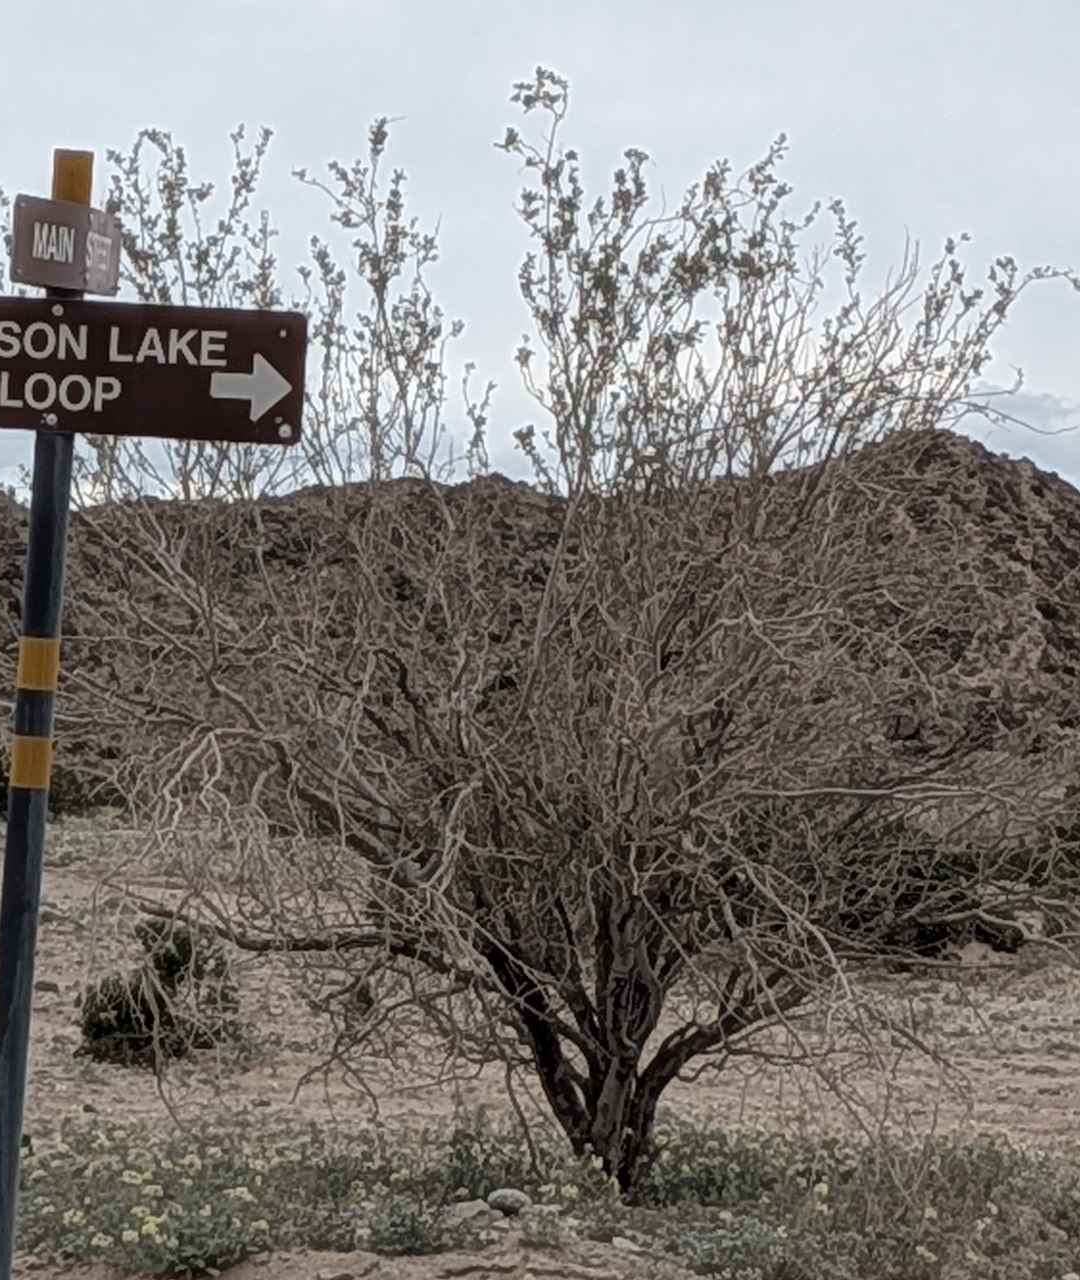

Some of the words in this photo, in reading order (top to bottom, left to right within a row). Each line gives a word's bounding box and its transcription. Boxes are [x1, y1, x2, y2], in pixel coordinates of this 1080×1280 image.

[32, 222, 75, 263] MAIN
[109, 327, 228, 366] LAKE
[0, 371, 121, 412] LOOP
